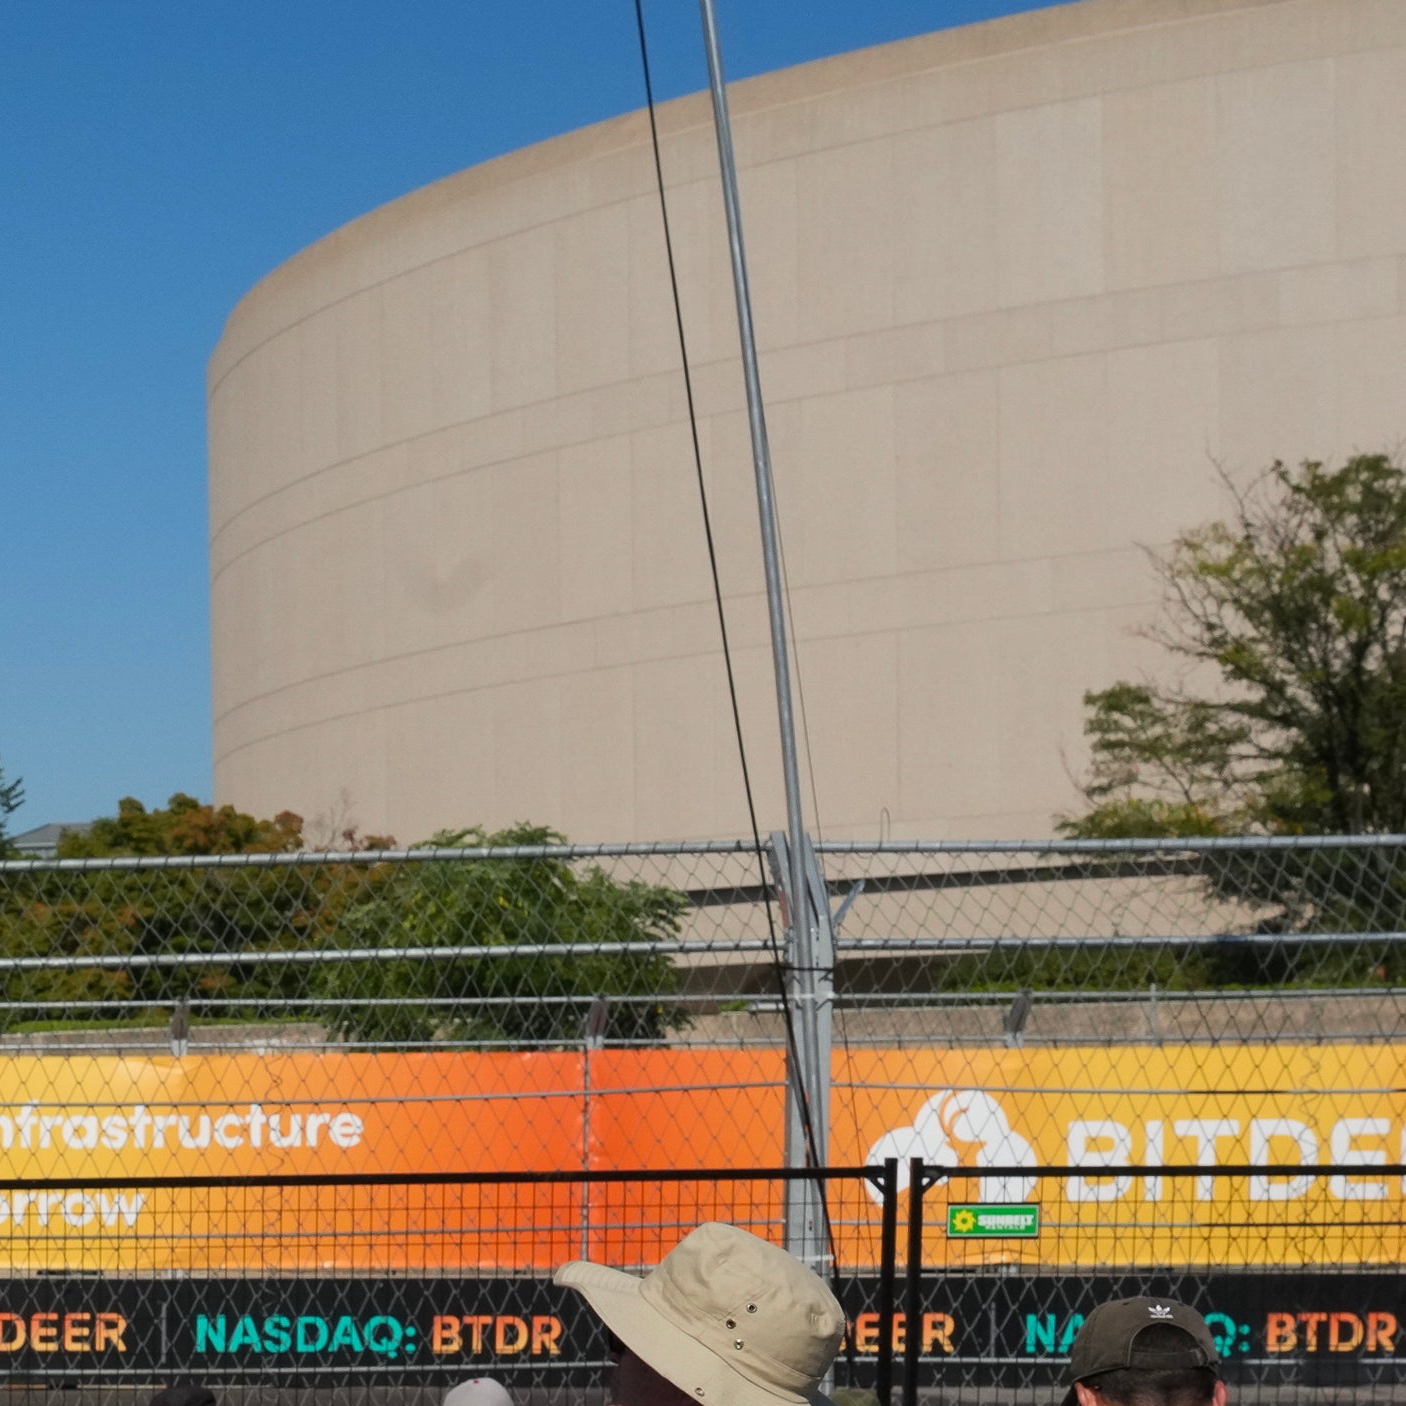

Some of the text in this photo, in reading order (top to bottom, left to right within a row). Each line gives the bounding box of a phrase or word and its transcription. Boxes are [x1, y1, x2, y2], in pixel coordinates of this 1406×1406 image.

[1066, 1118, 1406, 1202] BITDE
[196, 1313, 561, 1359] NASDAQ: BTDR
[1266, 1312, 1397, 1352] BTDR
